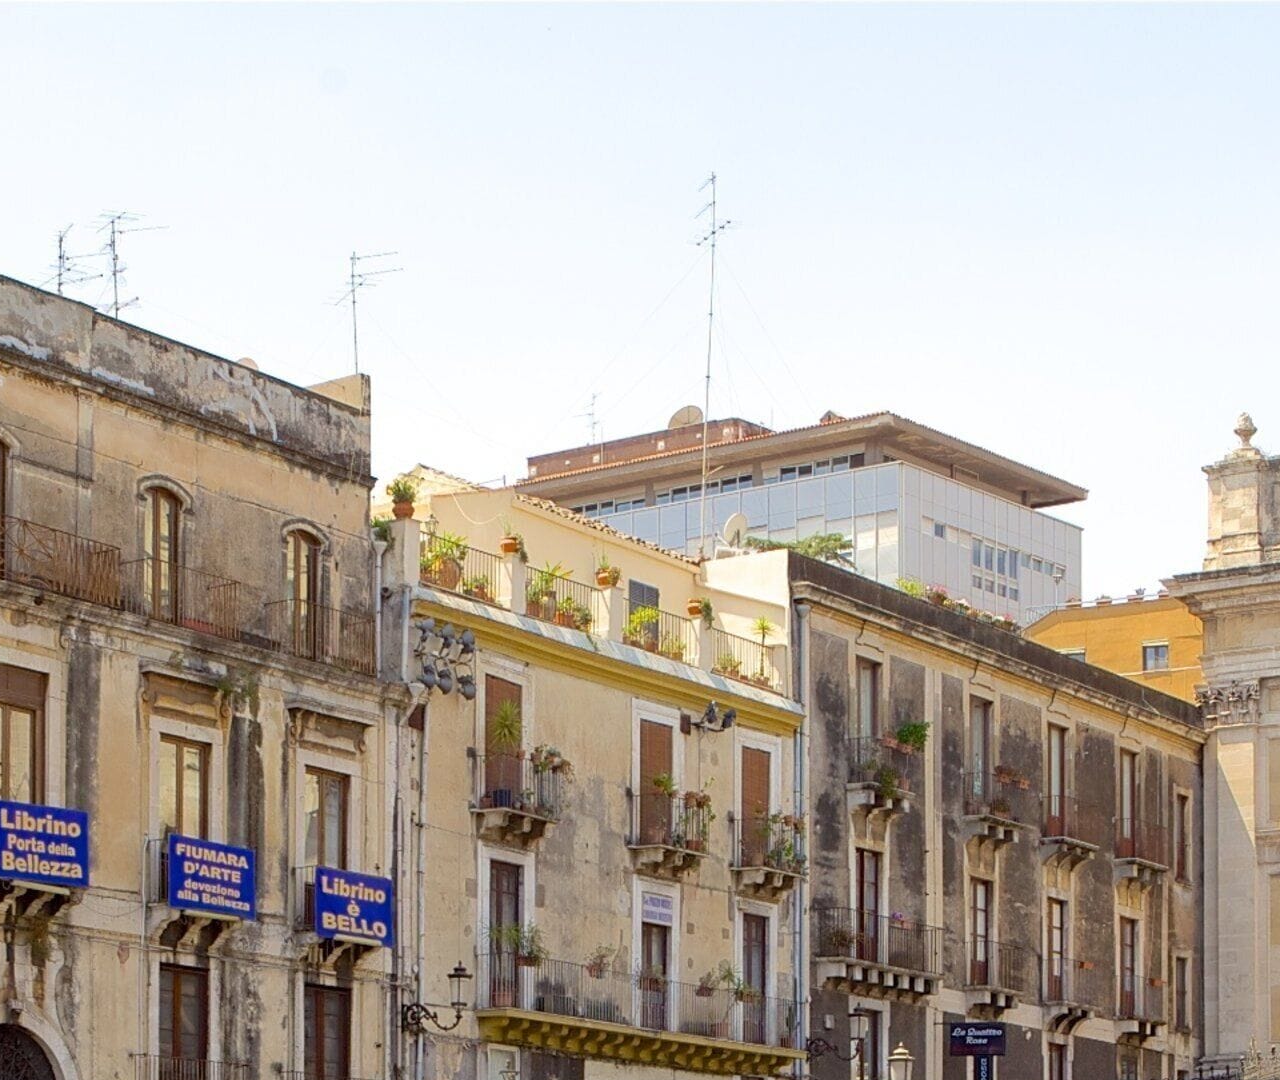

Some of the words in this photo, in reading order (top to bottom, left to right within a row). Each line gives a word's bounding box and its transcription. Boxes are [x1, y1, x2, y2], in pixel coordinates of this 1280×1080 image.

[0, 808, 81, 838] Librino
[7, 833, 45, 853] Porta
[47, 842, 76, 857] della
[176, 843, 249, 869] FIUMARA
[1, 850, 83, 879] Bellezza
[183, 861, 242, 884] D'ARTE
[177, 889, 199, 902] alla
[201, 893, 250, 911] Bellezza
[183, 878, 241, 899] devozione
[321, 876, 386, 904] Librino
[347, 899, 360, 917] è
[321, 911, 387, 938] BELLO
